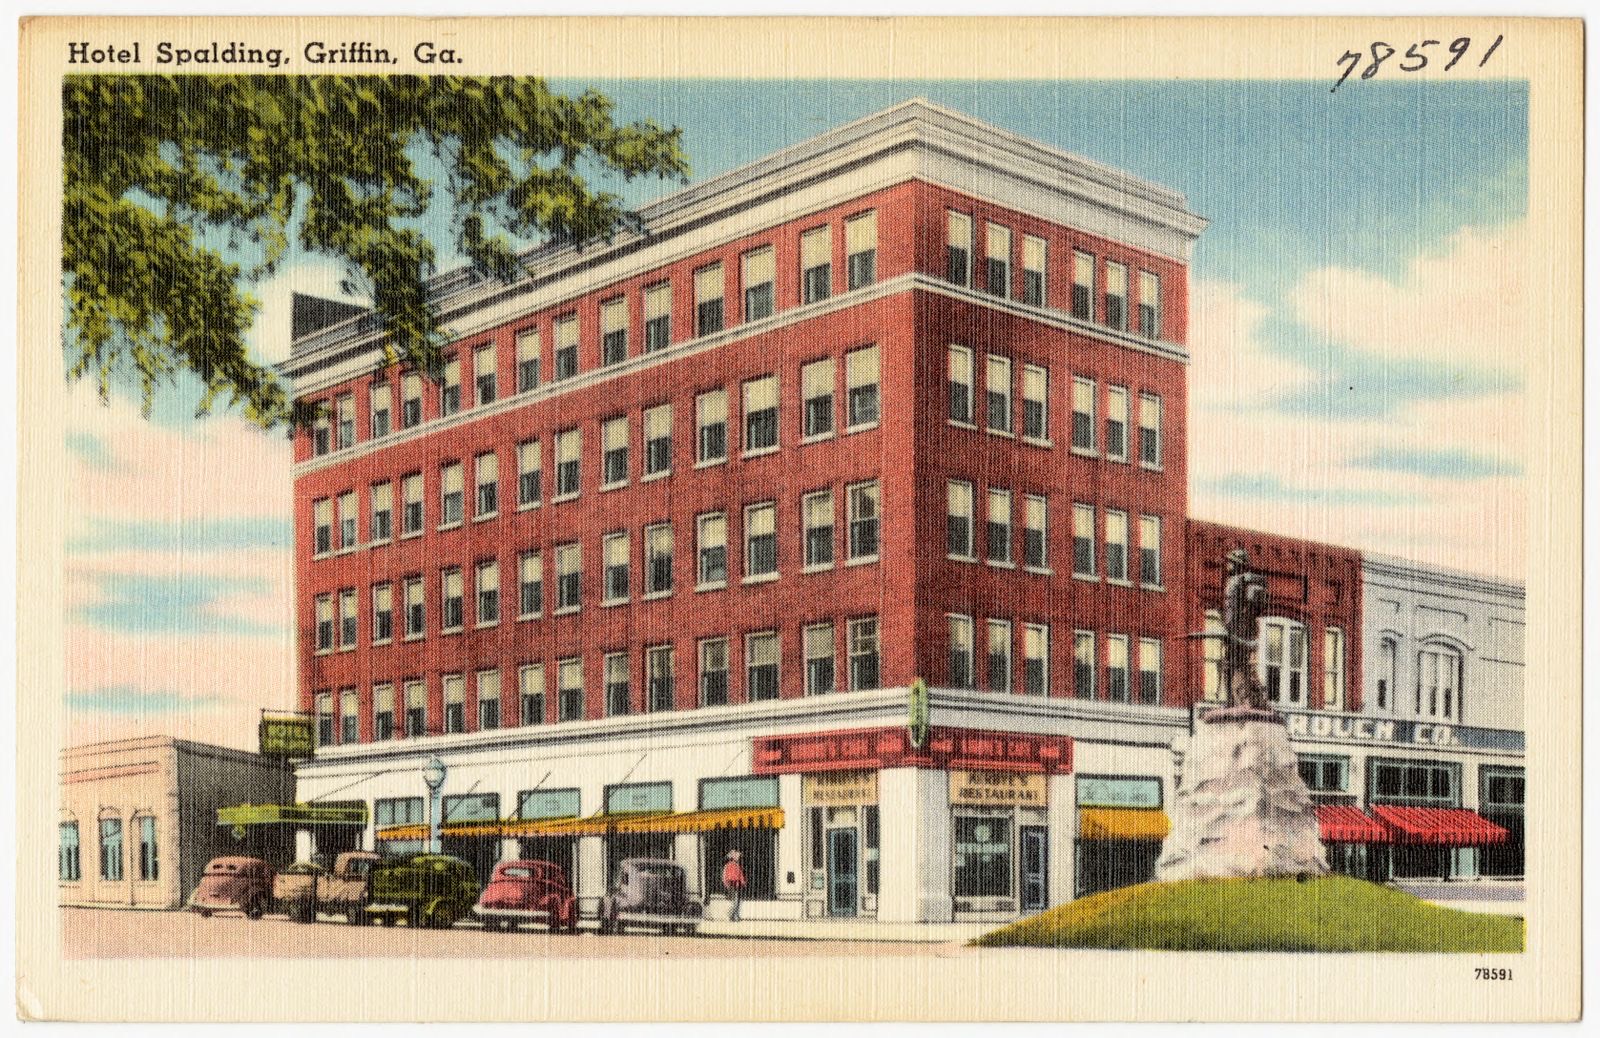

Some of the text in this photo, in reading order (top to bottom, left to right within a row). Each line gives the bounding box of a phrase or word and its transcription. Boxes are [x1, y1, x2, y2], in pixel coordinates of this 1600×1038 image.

[68, 41, 464, 67] Hotel Spalding, Griffin, Ga.
[1330, 34, 1504, 93] 78591
[959, 787, 1038, 800] RESTAURANT
[1474, 967, 1513, 981] 78591
